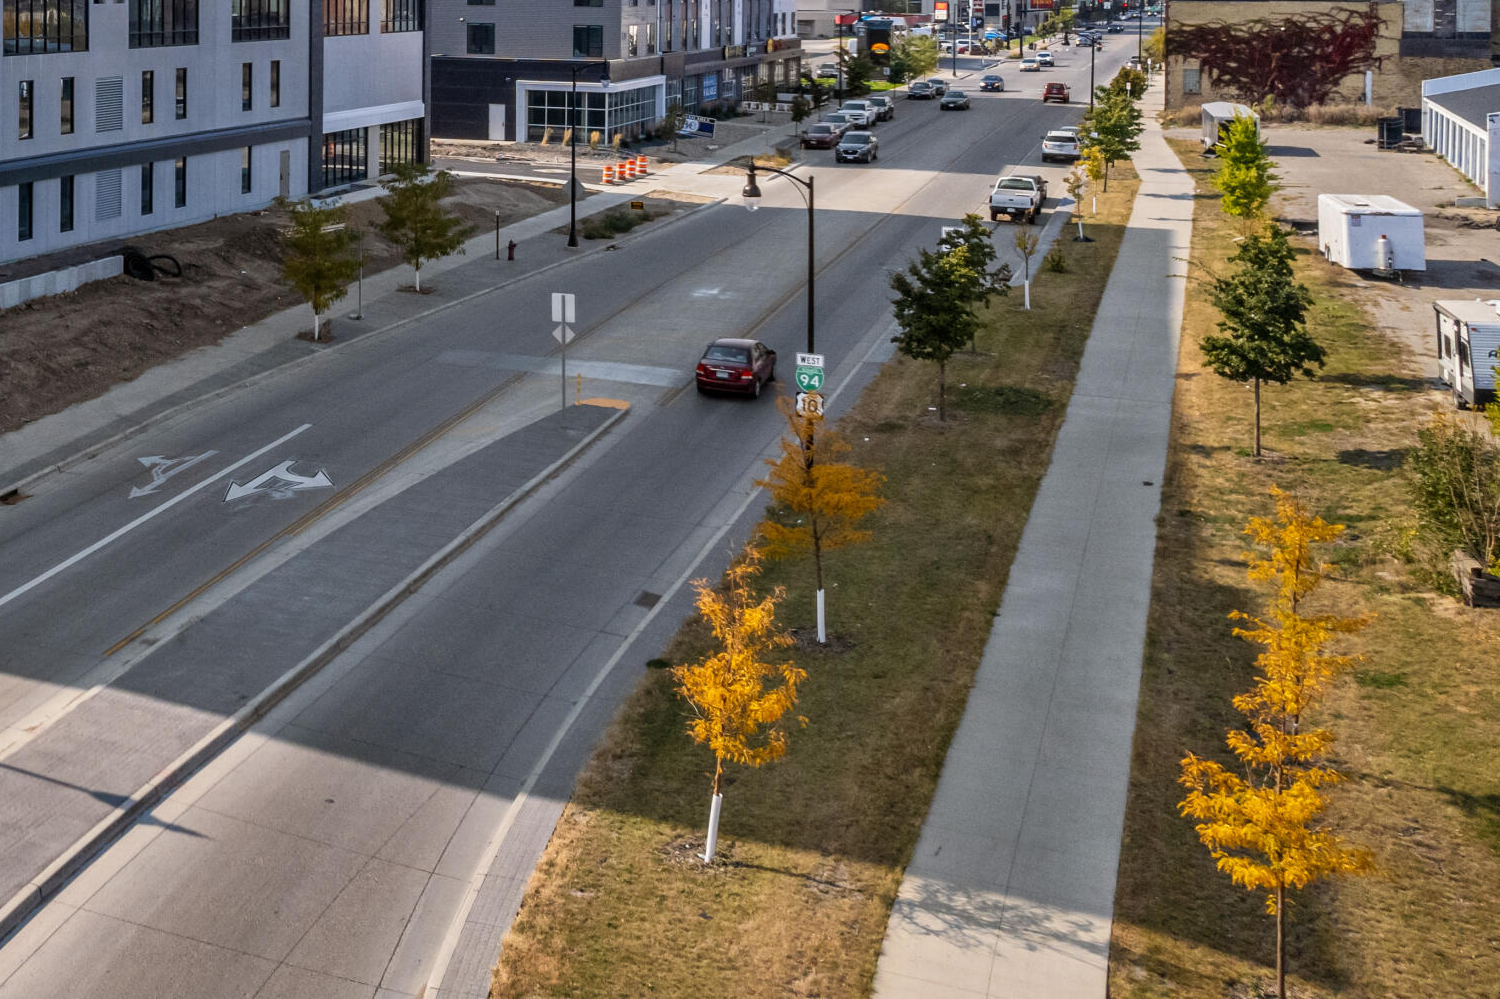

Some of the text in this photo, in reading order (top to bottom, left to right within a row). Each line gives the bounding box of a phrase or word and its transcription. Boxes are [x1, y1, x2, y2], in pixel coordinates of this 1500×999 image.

[801, 356, 820, 364] WEST
[800, 374, 820, 388] 94
[802, 398, 817, 412] 10
